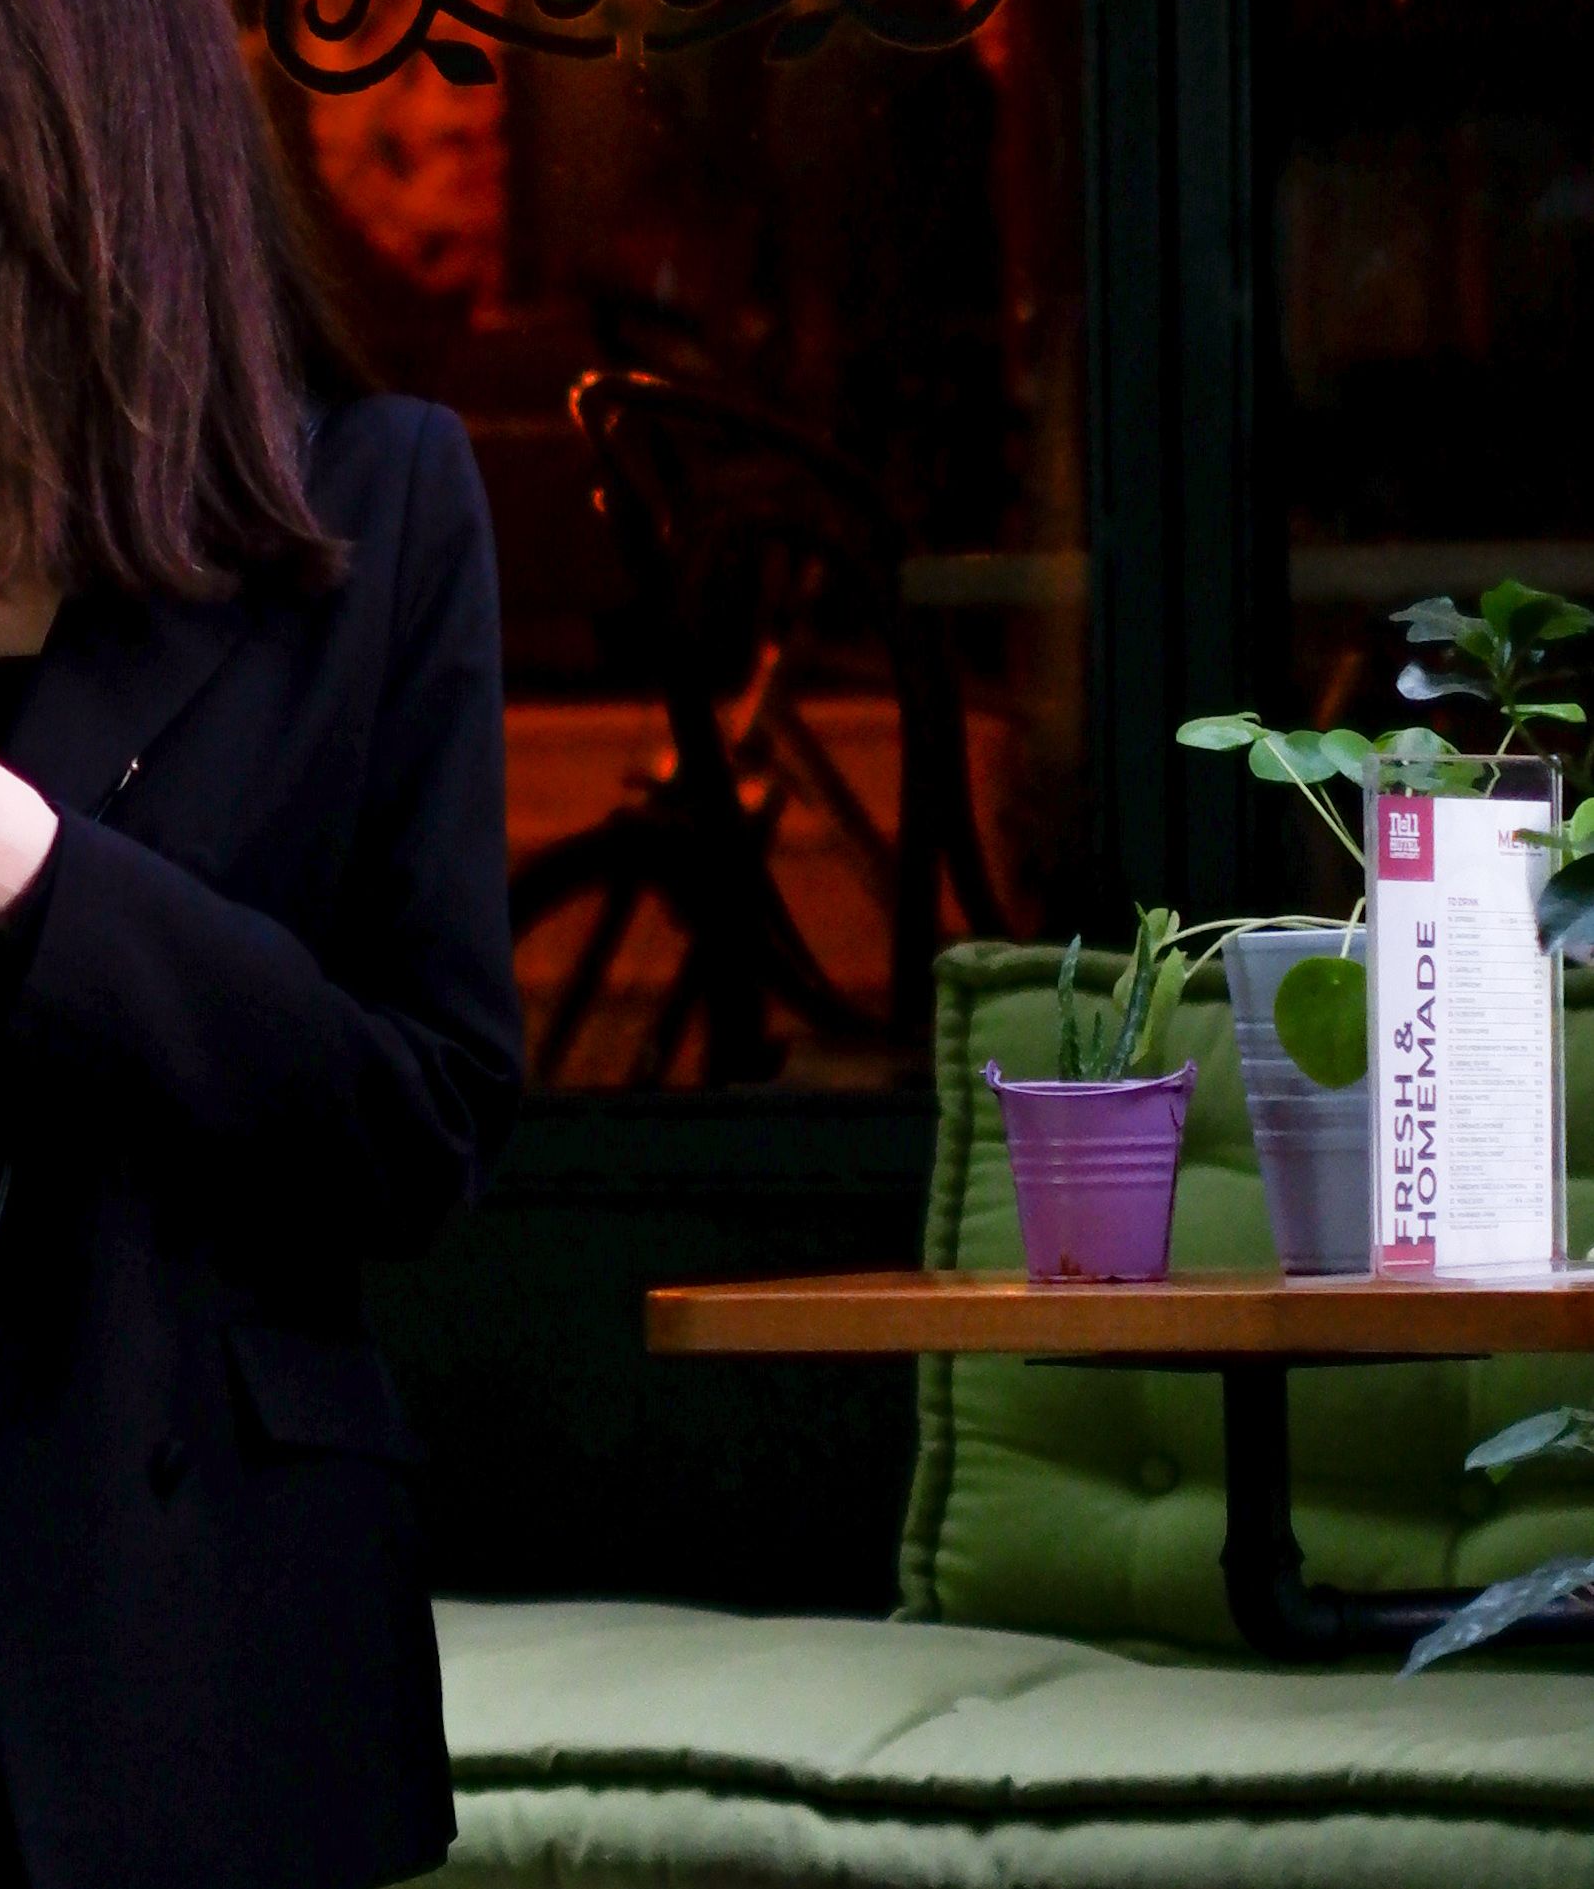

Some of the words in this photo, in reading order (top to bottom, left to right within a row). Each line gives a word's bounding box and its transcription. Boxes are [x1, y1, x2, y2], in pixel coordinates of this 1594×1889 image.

[1394, 1021, 1414, 1054] &
[1417, 920, 1437, 1245] HOMEMADE
[1394, 1074, 1414, 1245] FRESH
